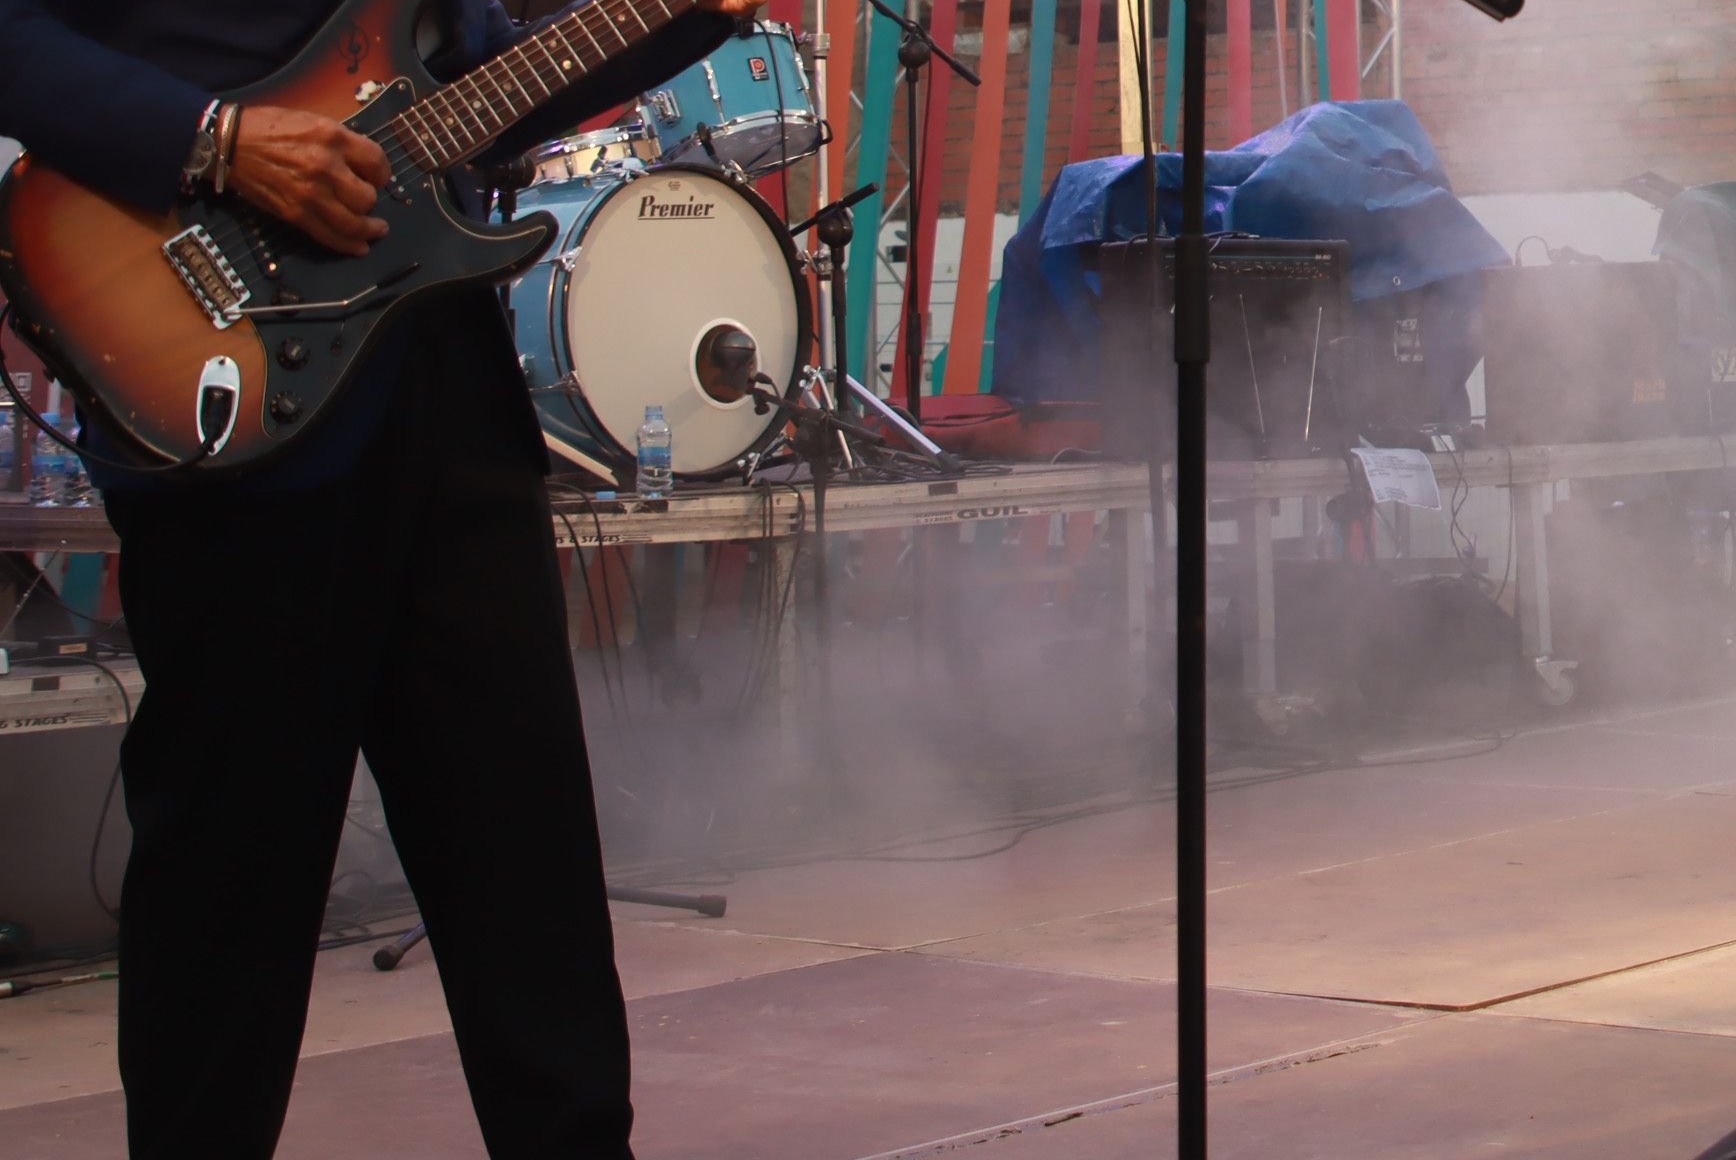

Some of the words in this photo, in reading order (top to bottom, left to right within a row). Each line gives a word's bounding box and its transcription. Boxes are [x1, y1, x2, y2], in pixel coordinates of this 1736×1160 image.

[638, 194, 715, 220] Premier
[956, 505, 1029, 520] GUIL
[15, 715, 68, 728] STAGES
